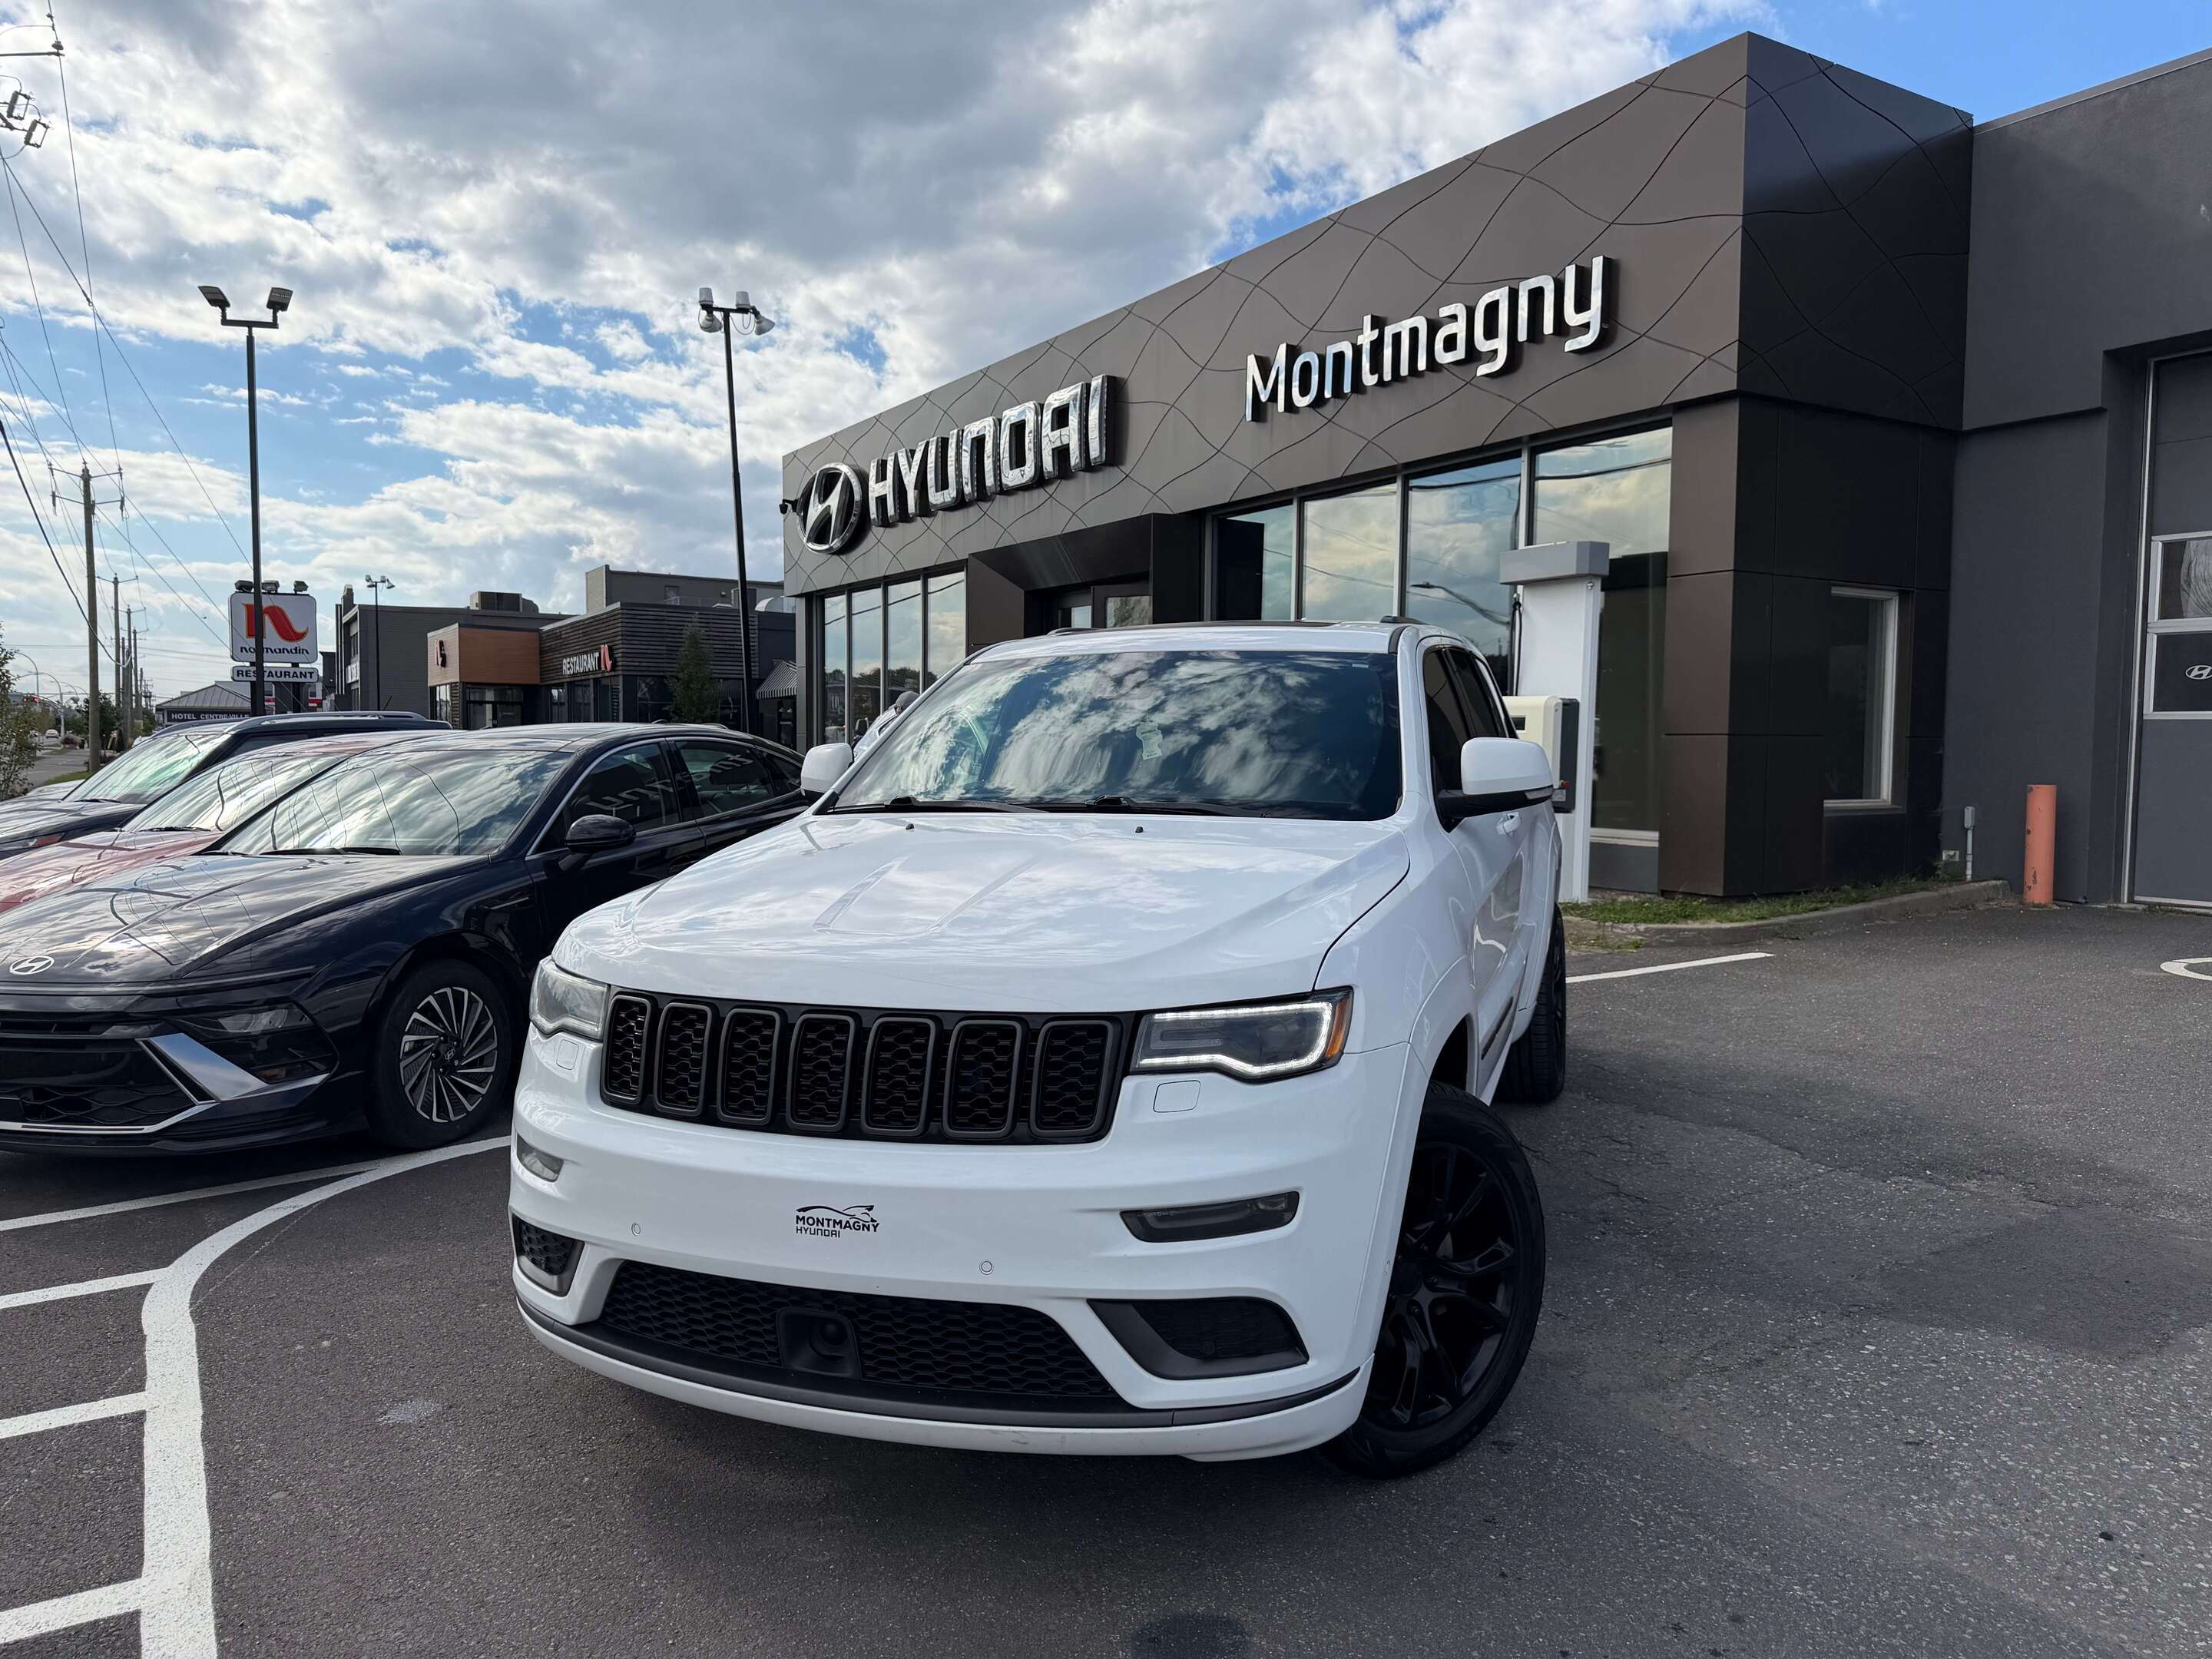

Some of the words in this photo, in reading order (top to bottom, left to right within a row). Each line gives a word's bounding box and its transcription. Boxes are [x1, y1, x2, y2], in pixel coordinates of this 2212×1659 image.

[1244, 254, 1606, 422] Montmagny
[869, 373, 1108, 528] HYUNDAI
[240, 646, 310, 655] nomandin
[563, 652, 599, 675] RESTAURANT
[796, 1215, 879, 1233] MONTMAGNY
[796, 1227, 841, 1238] HYUNDAI
